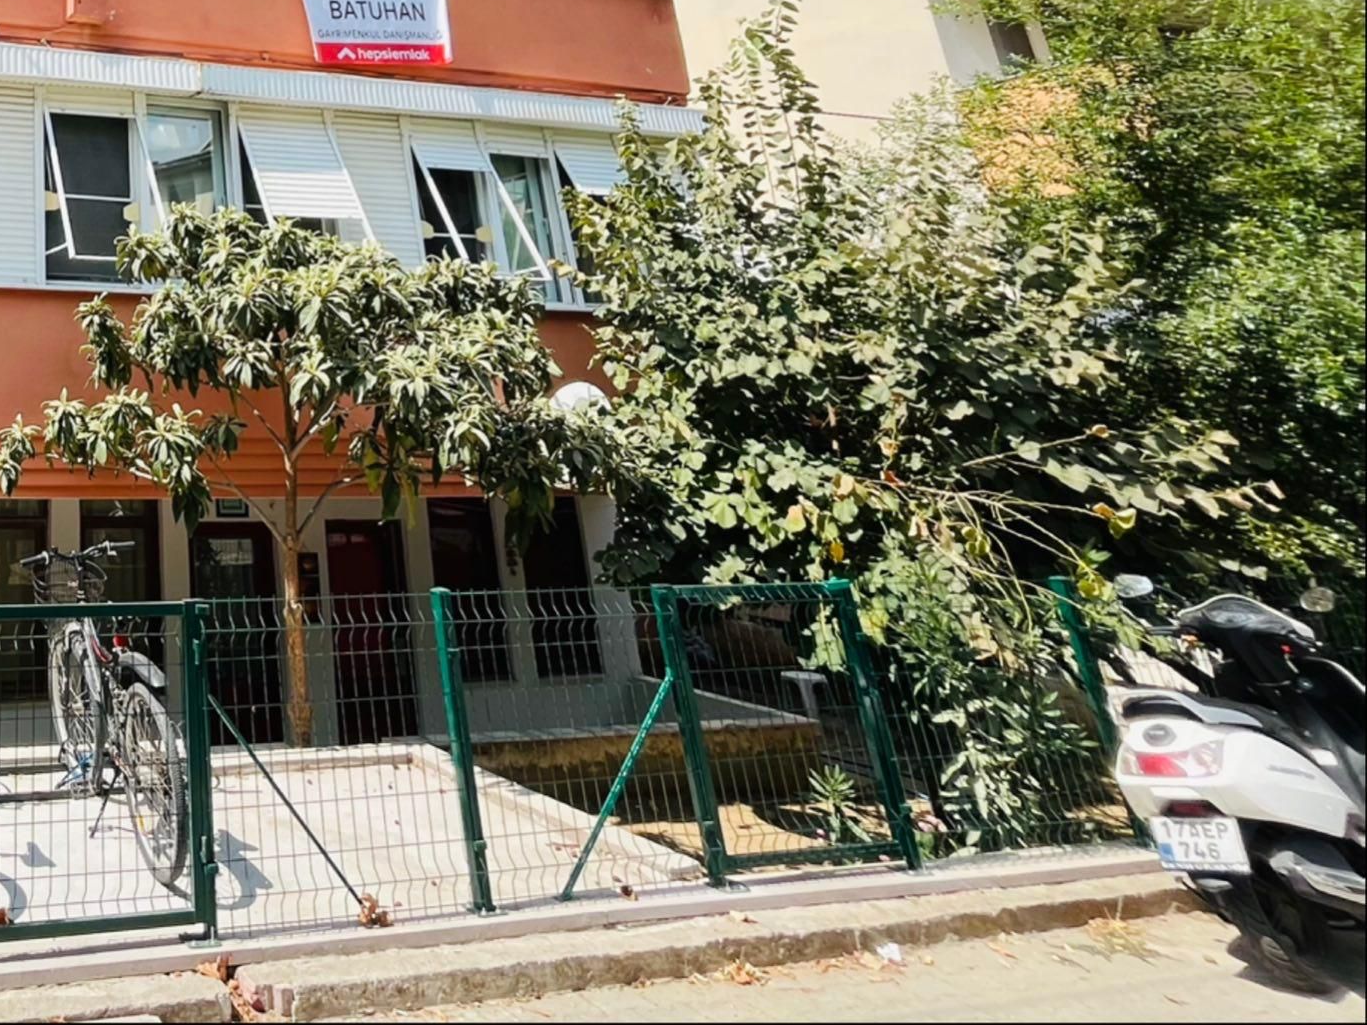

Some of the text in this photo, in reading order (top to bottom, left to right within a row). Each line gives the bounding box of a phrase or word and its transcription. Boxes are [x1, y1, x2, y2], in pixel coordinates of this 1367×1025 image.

[329, 0, 426, 21] BATUHAN
[357, 47, 430, 62] hepsiemlak
[1178, 842, 1221, 860] 746
